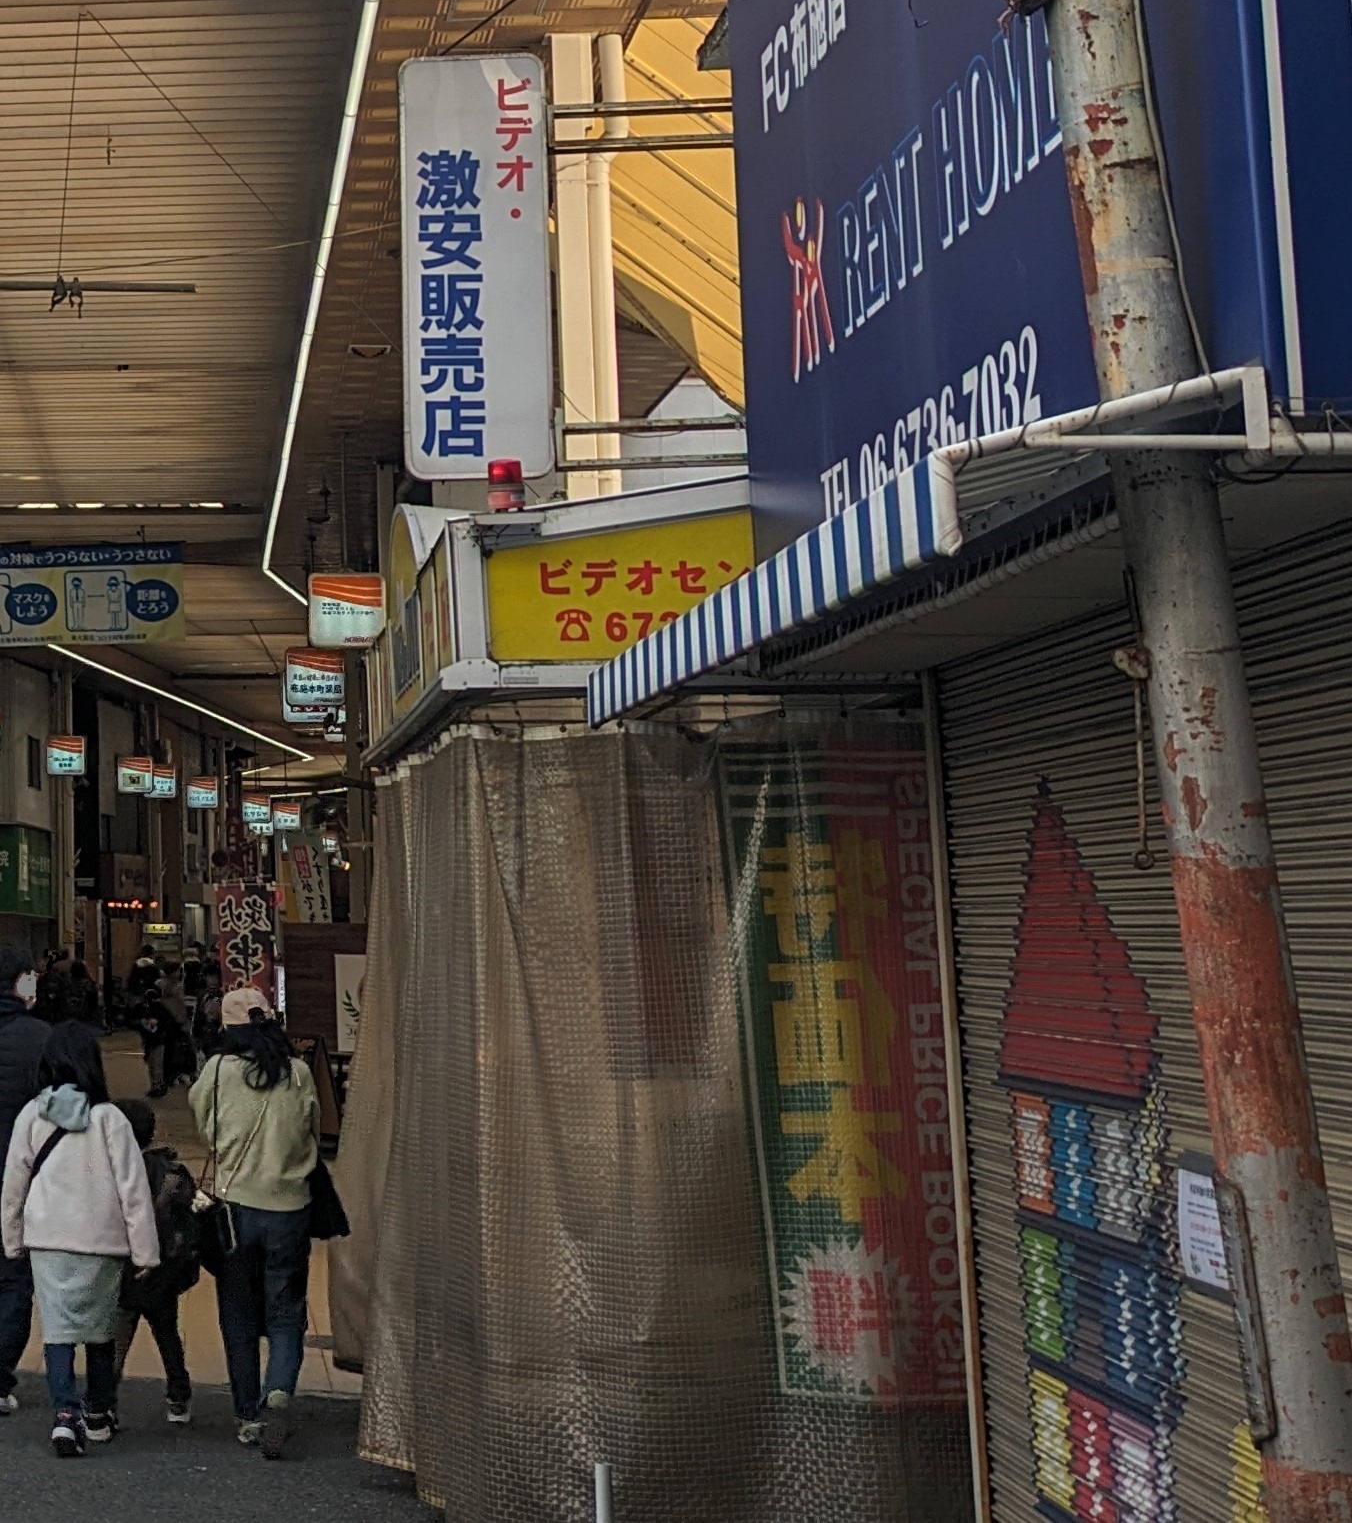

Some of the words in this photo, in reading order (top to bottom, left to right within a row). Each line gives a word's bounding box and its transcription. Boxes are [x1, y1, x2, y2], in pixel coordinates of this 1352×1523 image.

[415, 150, 486, 458] 激安販売店
[836, 126, 923, 338] RENT
